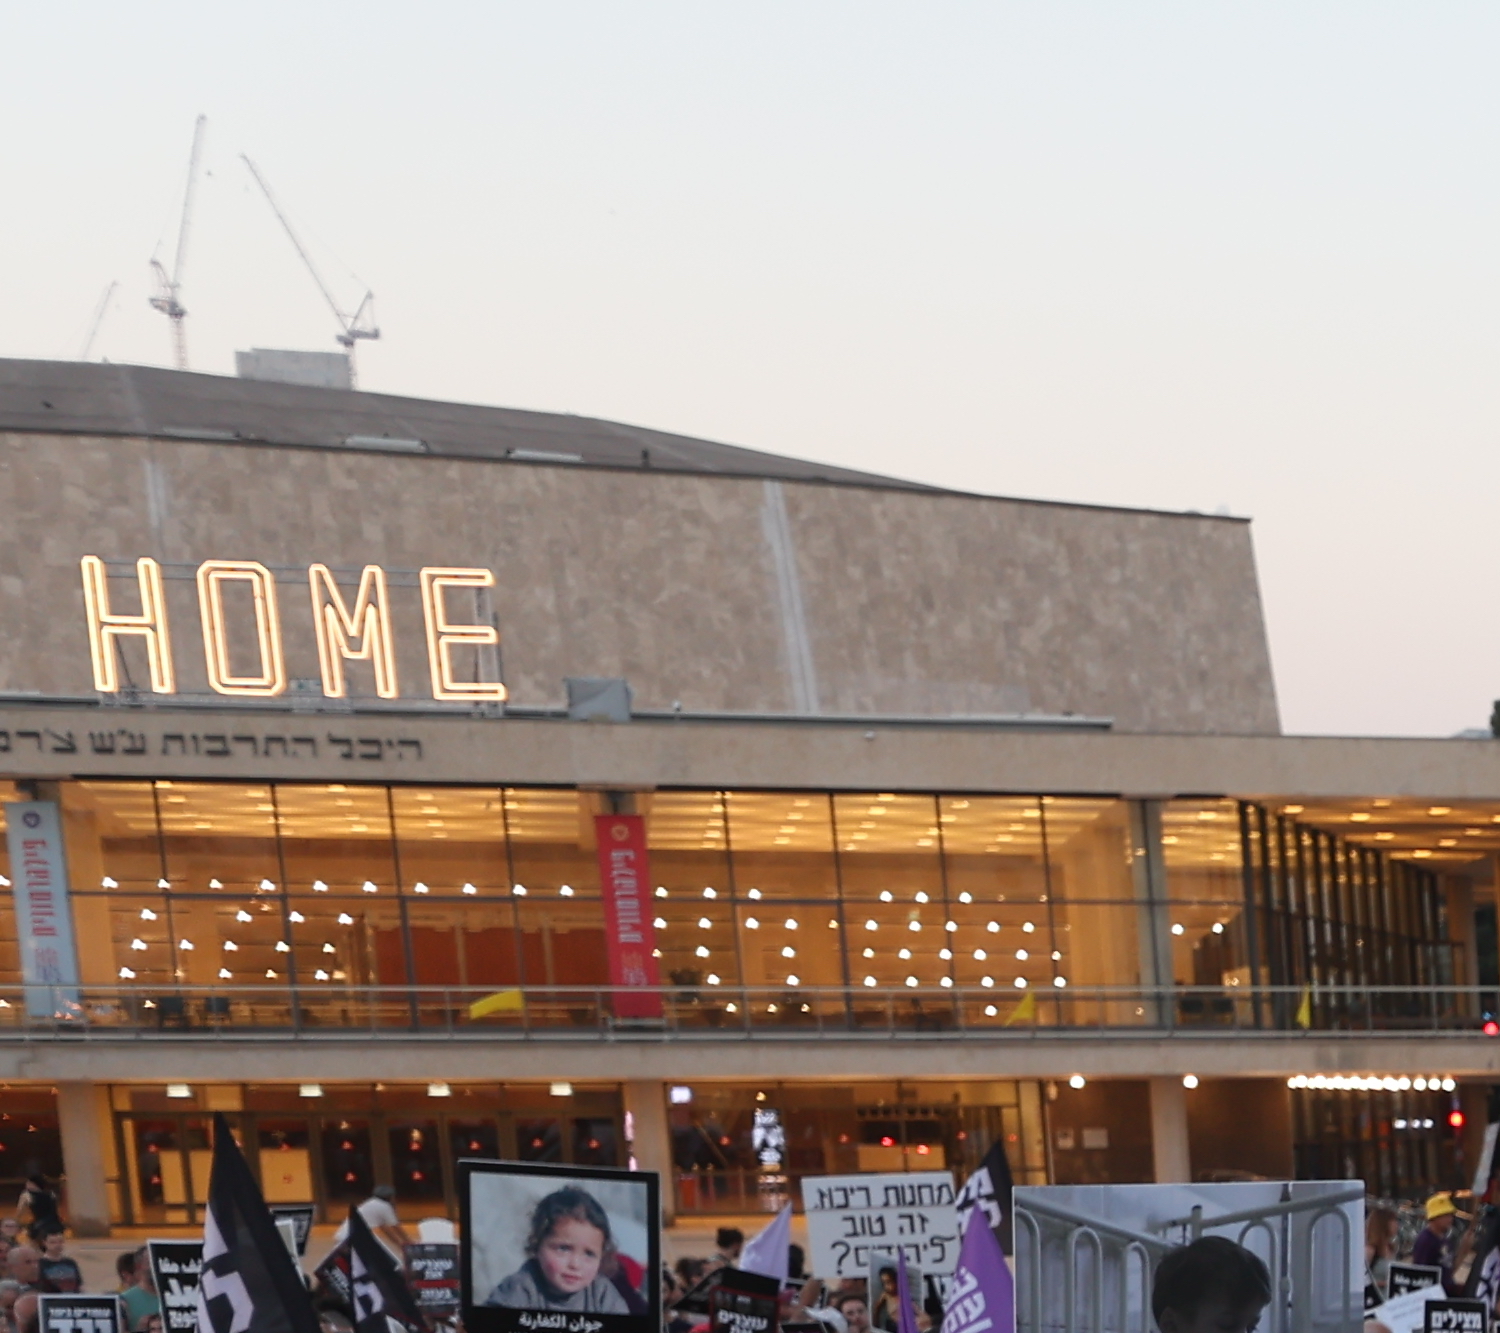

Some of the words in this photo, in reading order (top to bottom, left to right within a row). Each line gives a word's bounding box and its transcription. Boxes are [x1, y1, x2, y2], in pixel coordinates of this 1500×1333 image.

[80, 554, 508, 702] HOME
[160, 730, 318, 758] התרבות
[327, 731, 423, 760] היכל
[884, 1182, 954, 1207] מחנות
[842, 1213, 886, 1238] טוב
[898, 1213, 930, 1236] זה
[1430, 1308, 1483, 1328] מצילים
